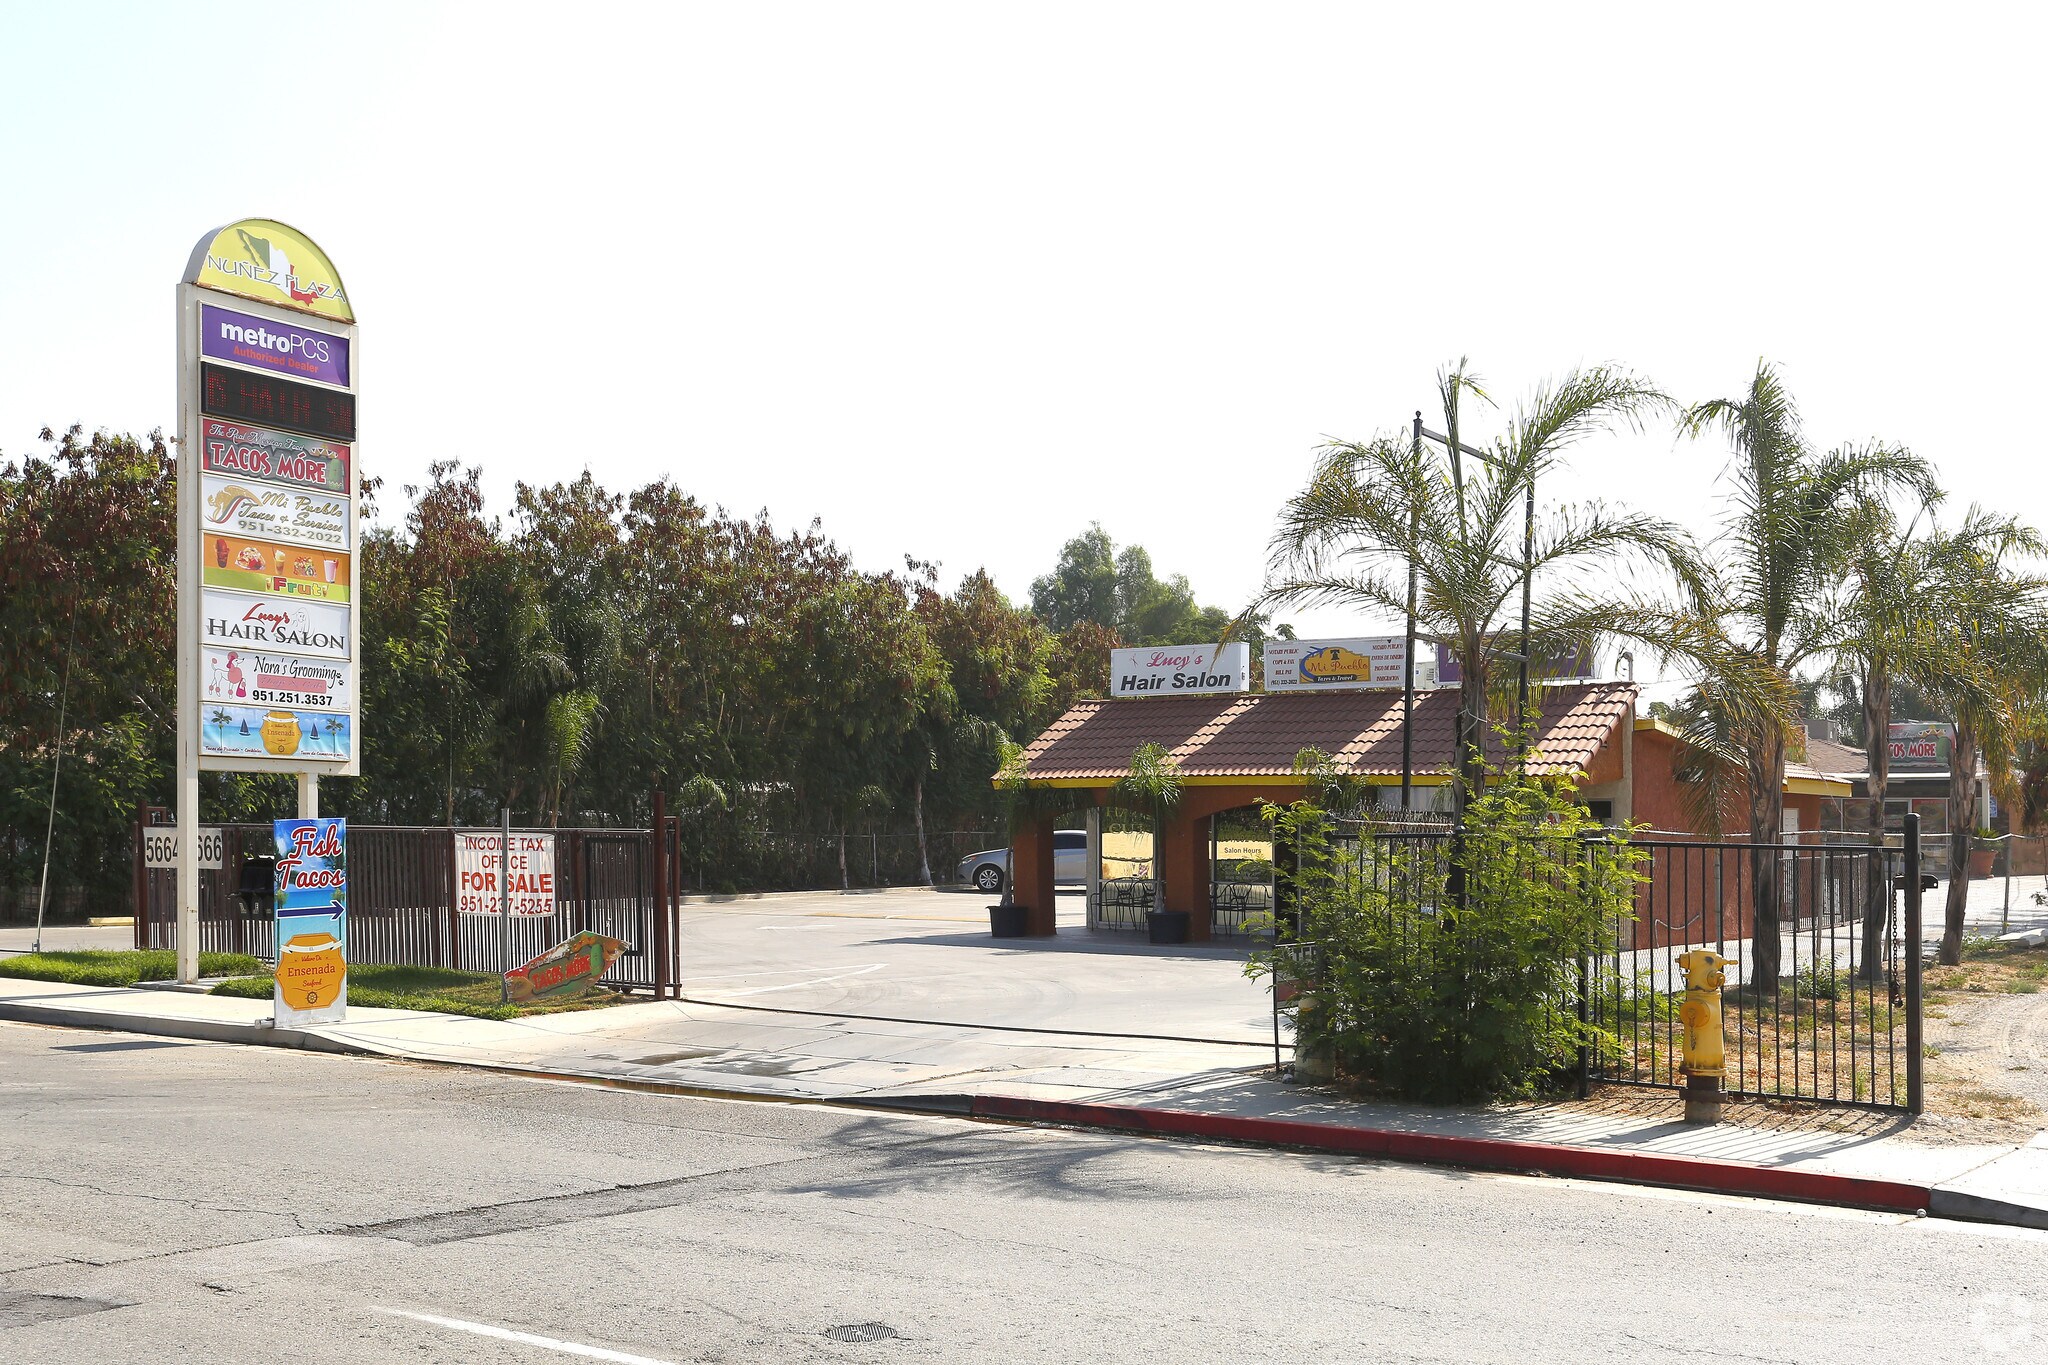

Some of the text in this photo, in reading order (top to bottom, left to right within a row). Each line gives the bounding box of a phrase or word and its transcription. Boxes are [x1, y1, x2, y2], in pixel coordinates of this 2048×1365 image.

[208, 254, 346, 303] NUÑEZ PLAZA
[221, 322, 330, 363] metroPCS
[233, 345, 319, 374] Authorized Dealer
[209, 423, 305, 451] The Real Mexican Food
[210, 442, 327, 484] TACOS MÓRE
[261, 491, 343, 517] Mi Pueblo
[238, 502, 343, 532] Taxes & Services
[238, 520, 342, 544] 951-332-2022
[242, 602, 290, 633] Lucy's
[207, 617, 345, 650] HAIR SALON
[254, 655, 337, 689] Nora's Grooming
[1146, 648, 1203, 671] Lucy's
[1308, 659, 1368, 673] Mi Pueblo
[1120, 674, 1166, 691] Hair
[1171, 671, 1231, 689] Salon
[252, 689, 333, 706] 951.251.3537
[267, 728, 295, 737] Ensenada
[1888, 739, 1937, 759] COS MÓRE
[288, 824, 343, 860] Fish
[520, 837, 544, 851] TAX
[481, 854, 528, 869] OFCE
[276, 859, 345, 891] Tacos
[461, 871, 553, 893] FOR SALE
[460, 895, 553, 915] 951-237-5255
[287, 963, 336, 977] Ensenada
